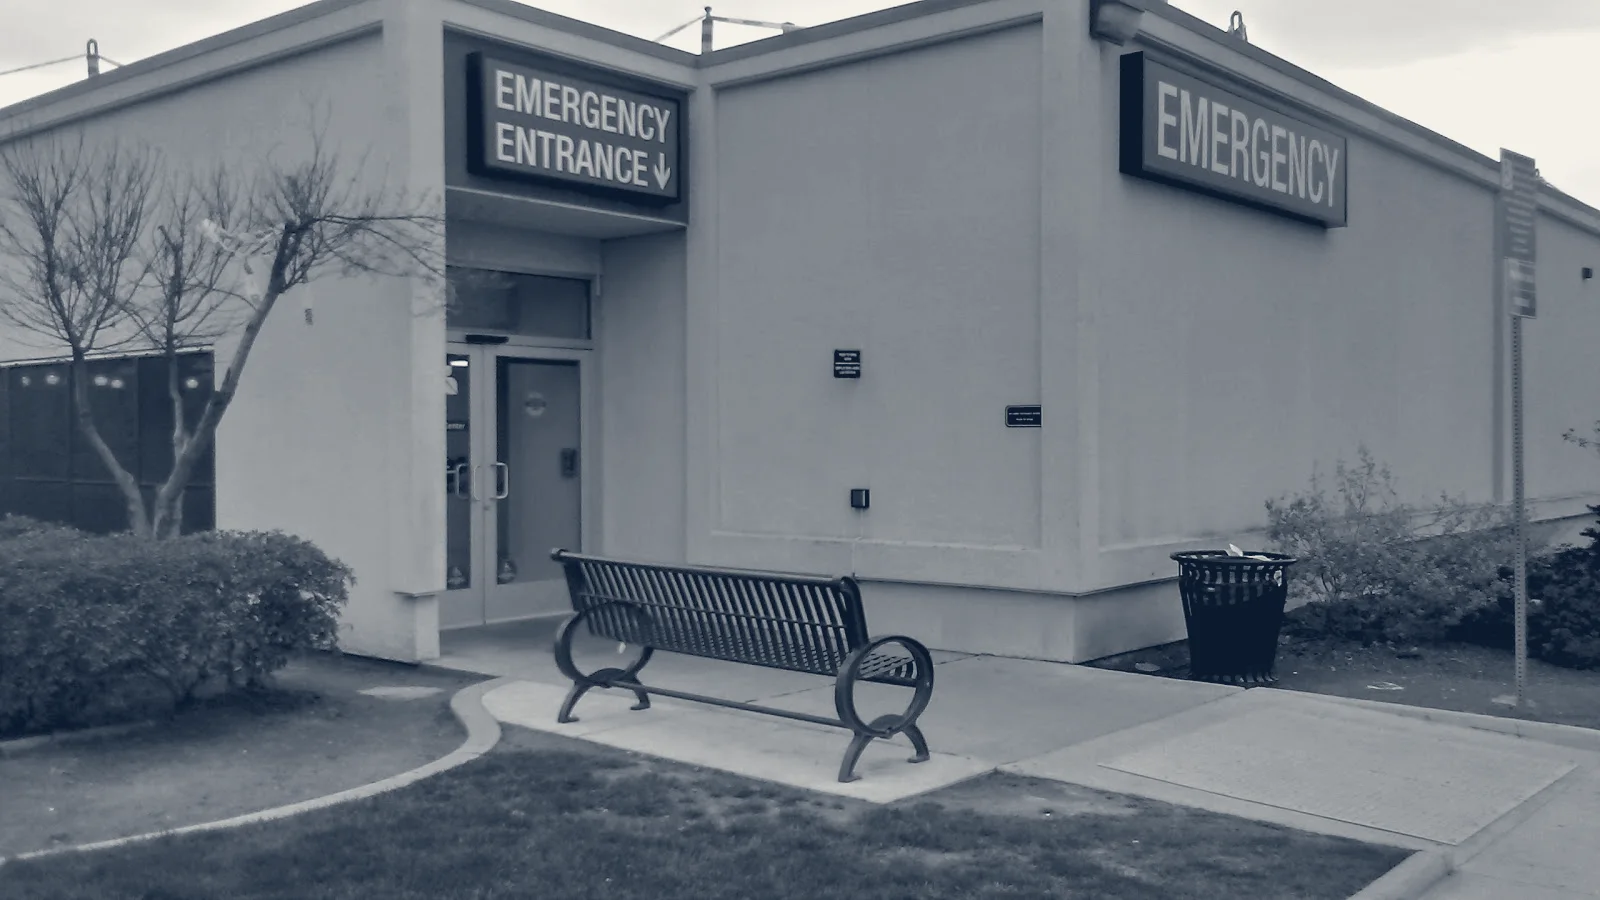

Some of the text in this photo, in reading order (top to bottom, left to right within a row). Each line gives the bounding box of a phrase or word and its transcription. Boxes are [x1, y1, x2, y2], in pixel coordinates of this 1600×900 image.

[495, 70, 670, 143] EMERGENCY
[495, 122, 648, 187] ENTRANCE
[1157, 81, 1339, 207] EMERGENCY
